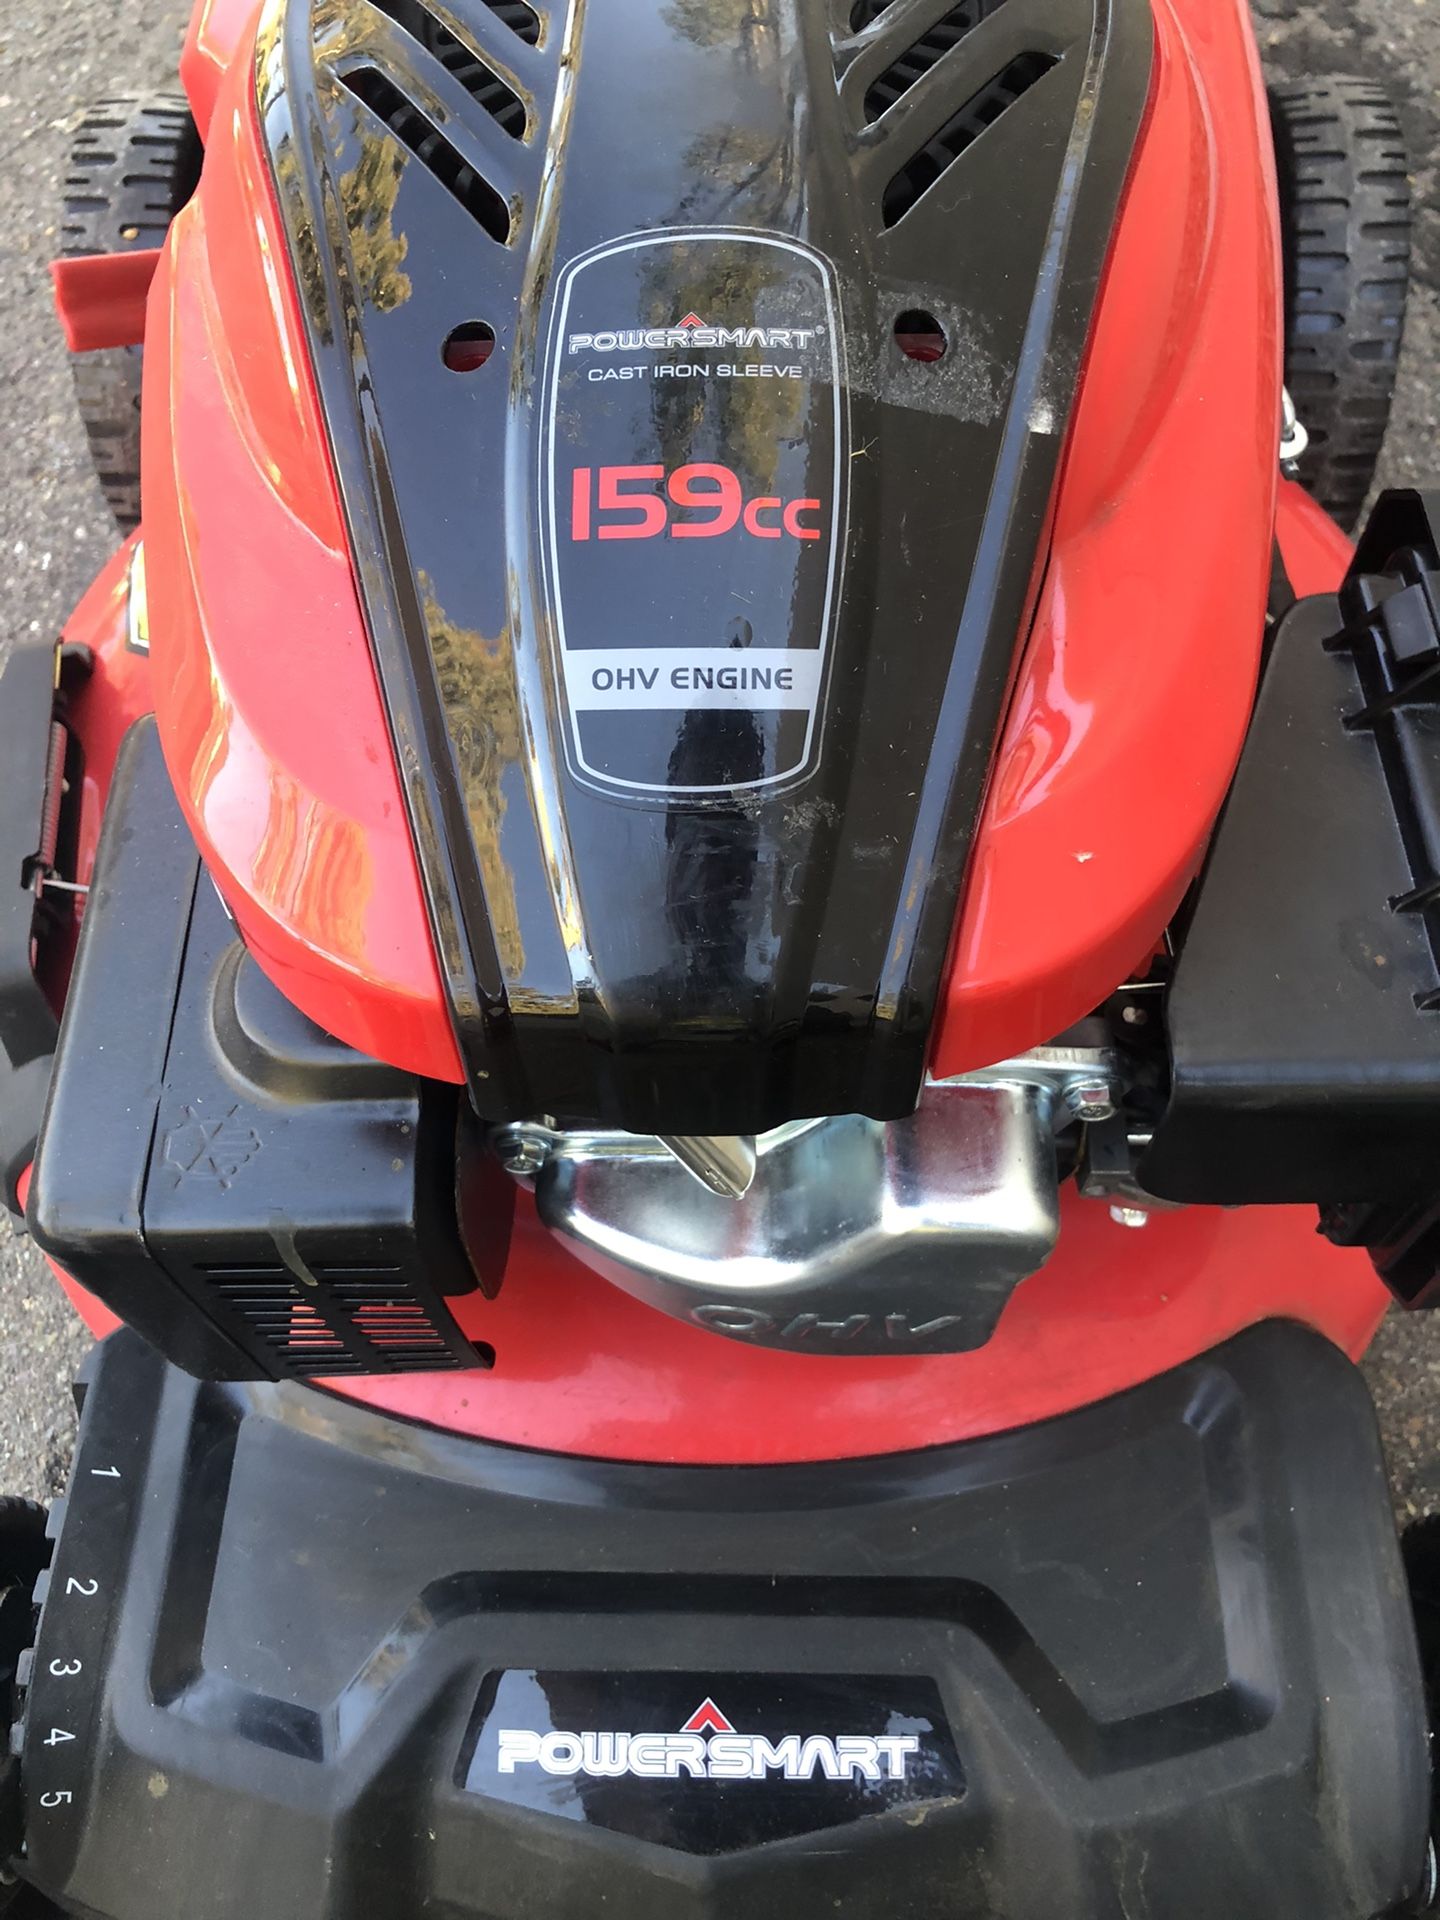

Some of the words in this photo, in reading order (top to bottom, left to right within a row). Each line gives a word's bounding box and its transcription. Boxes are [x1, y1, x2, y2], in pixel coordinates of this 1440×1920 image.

[569, 327, 815, 354] POWERSMART
[588, 366, 647, 381] CAST
[654, 364, 709, 378] IRON
[716, 364, 802, 378] SLEEVE
[572, 463, 820, 540] 159cc
[591, 667, 660, 691] OHV
[670, 667, 793, 690] ENGINE
[692, 1304, 961, 1340] OHV
[91, 1465, 121, 1478] 1
[65, 1577, 98, 1595] 2
[50, 1658, 82, 1676] 3
[43, 1727, 76, 1746] 4
[498, 1729, 919, 1779] POWERSMART
[40, 1790, 72, 1807] 5
